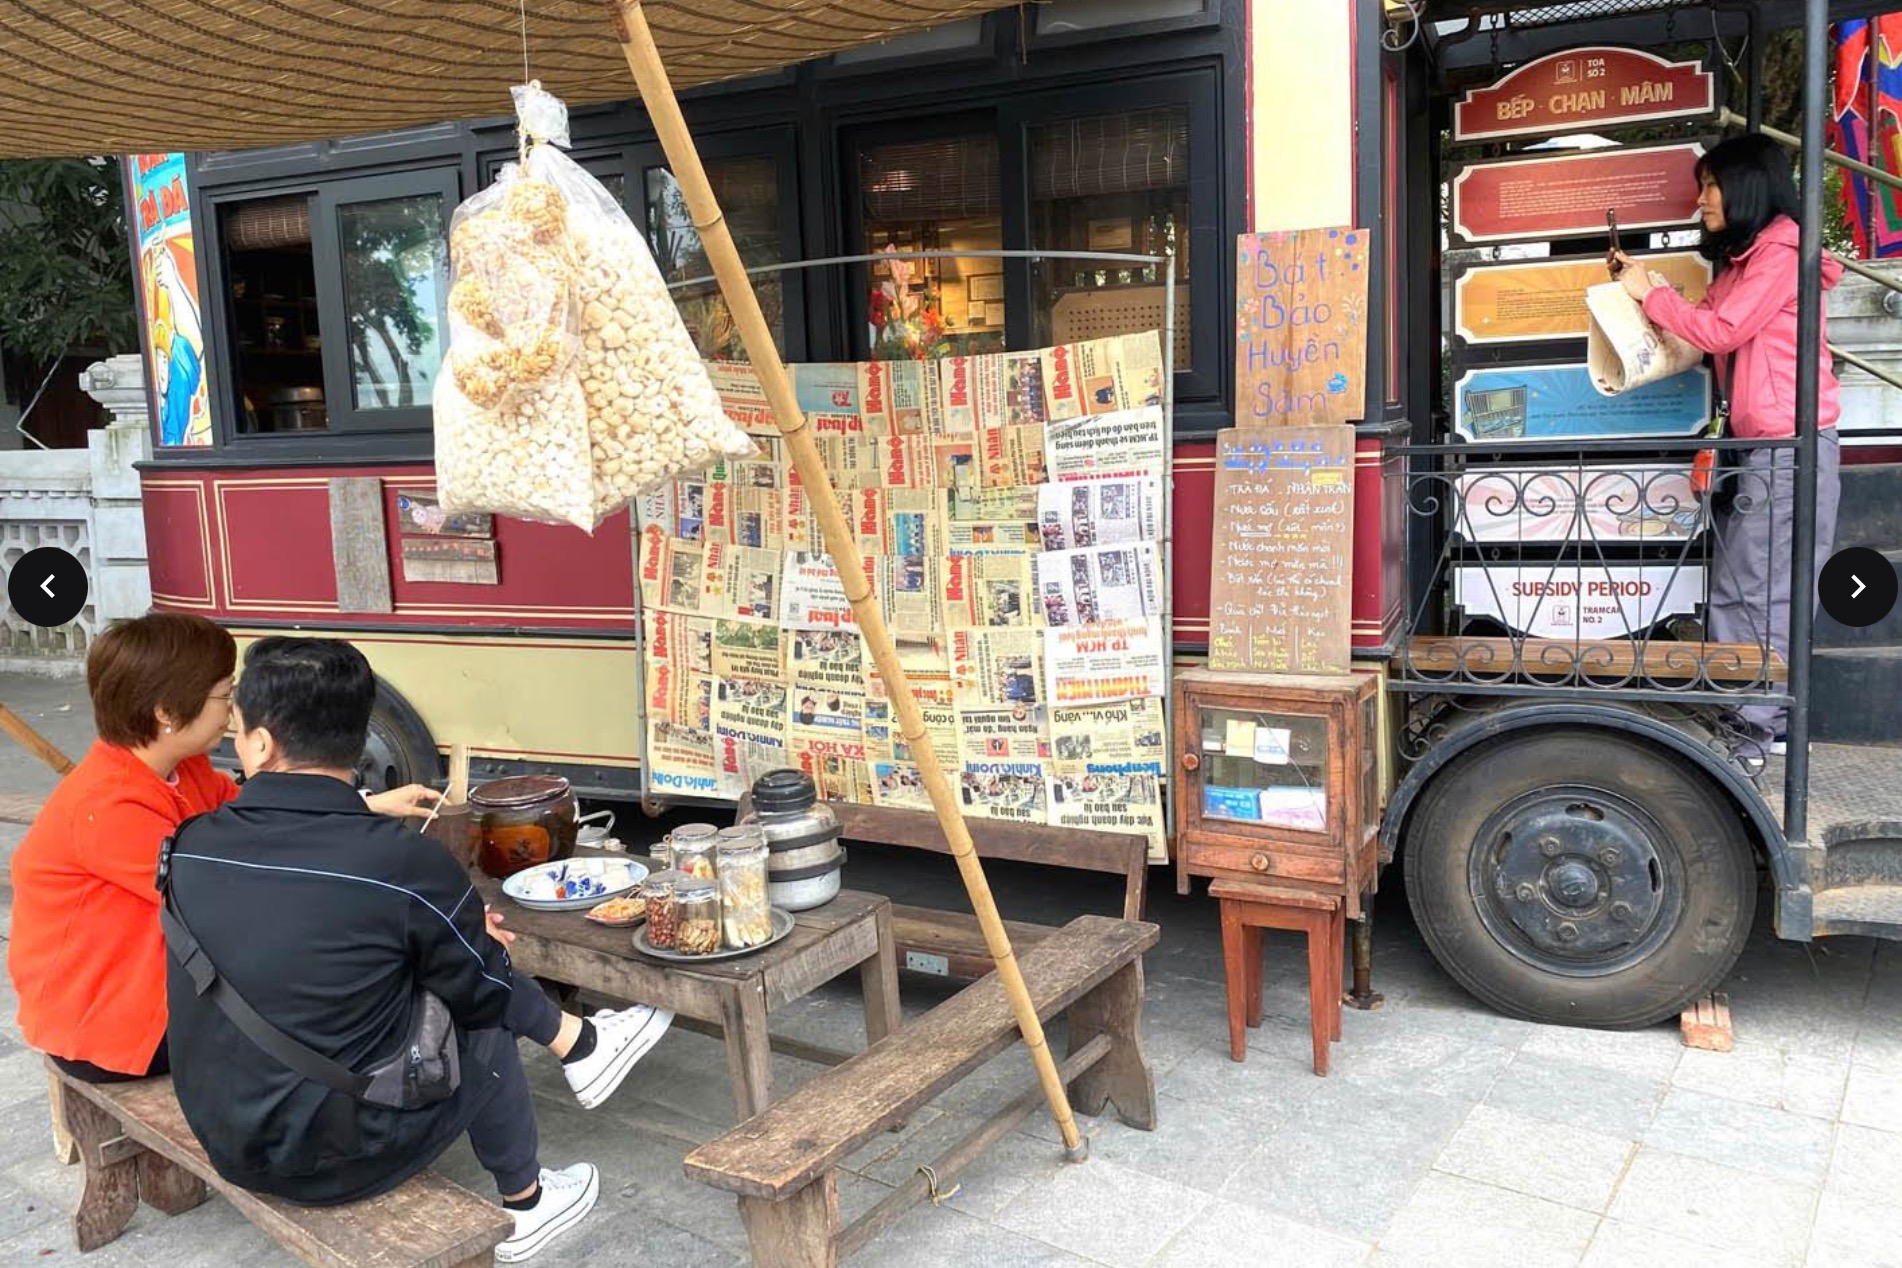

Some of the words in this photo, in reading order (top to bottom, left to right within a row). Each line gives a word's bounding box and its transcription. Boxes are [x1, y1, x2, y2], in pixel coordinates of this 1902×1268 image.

[1587, 58, 1605, 68] TOA
[1598, 68, 1606, 77] 2
[1496, 94, 1536, 120] BẾP
[1548, 90, 1606, 114] CHẠN
[1620, 81, 1673, 106] MÂM
[1261, 293, 1332, 329] Bảo
[1247, 333, 1340, 373] Huyền
[1511, 581, 1582, 597] SUBSIDY
[1587, 581, 1651, 597] PERIOD
[1597, 616, 1603, 624] 2
